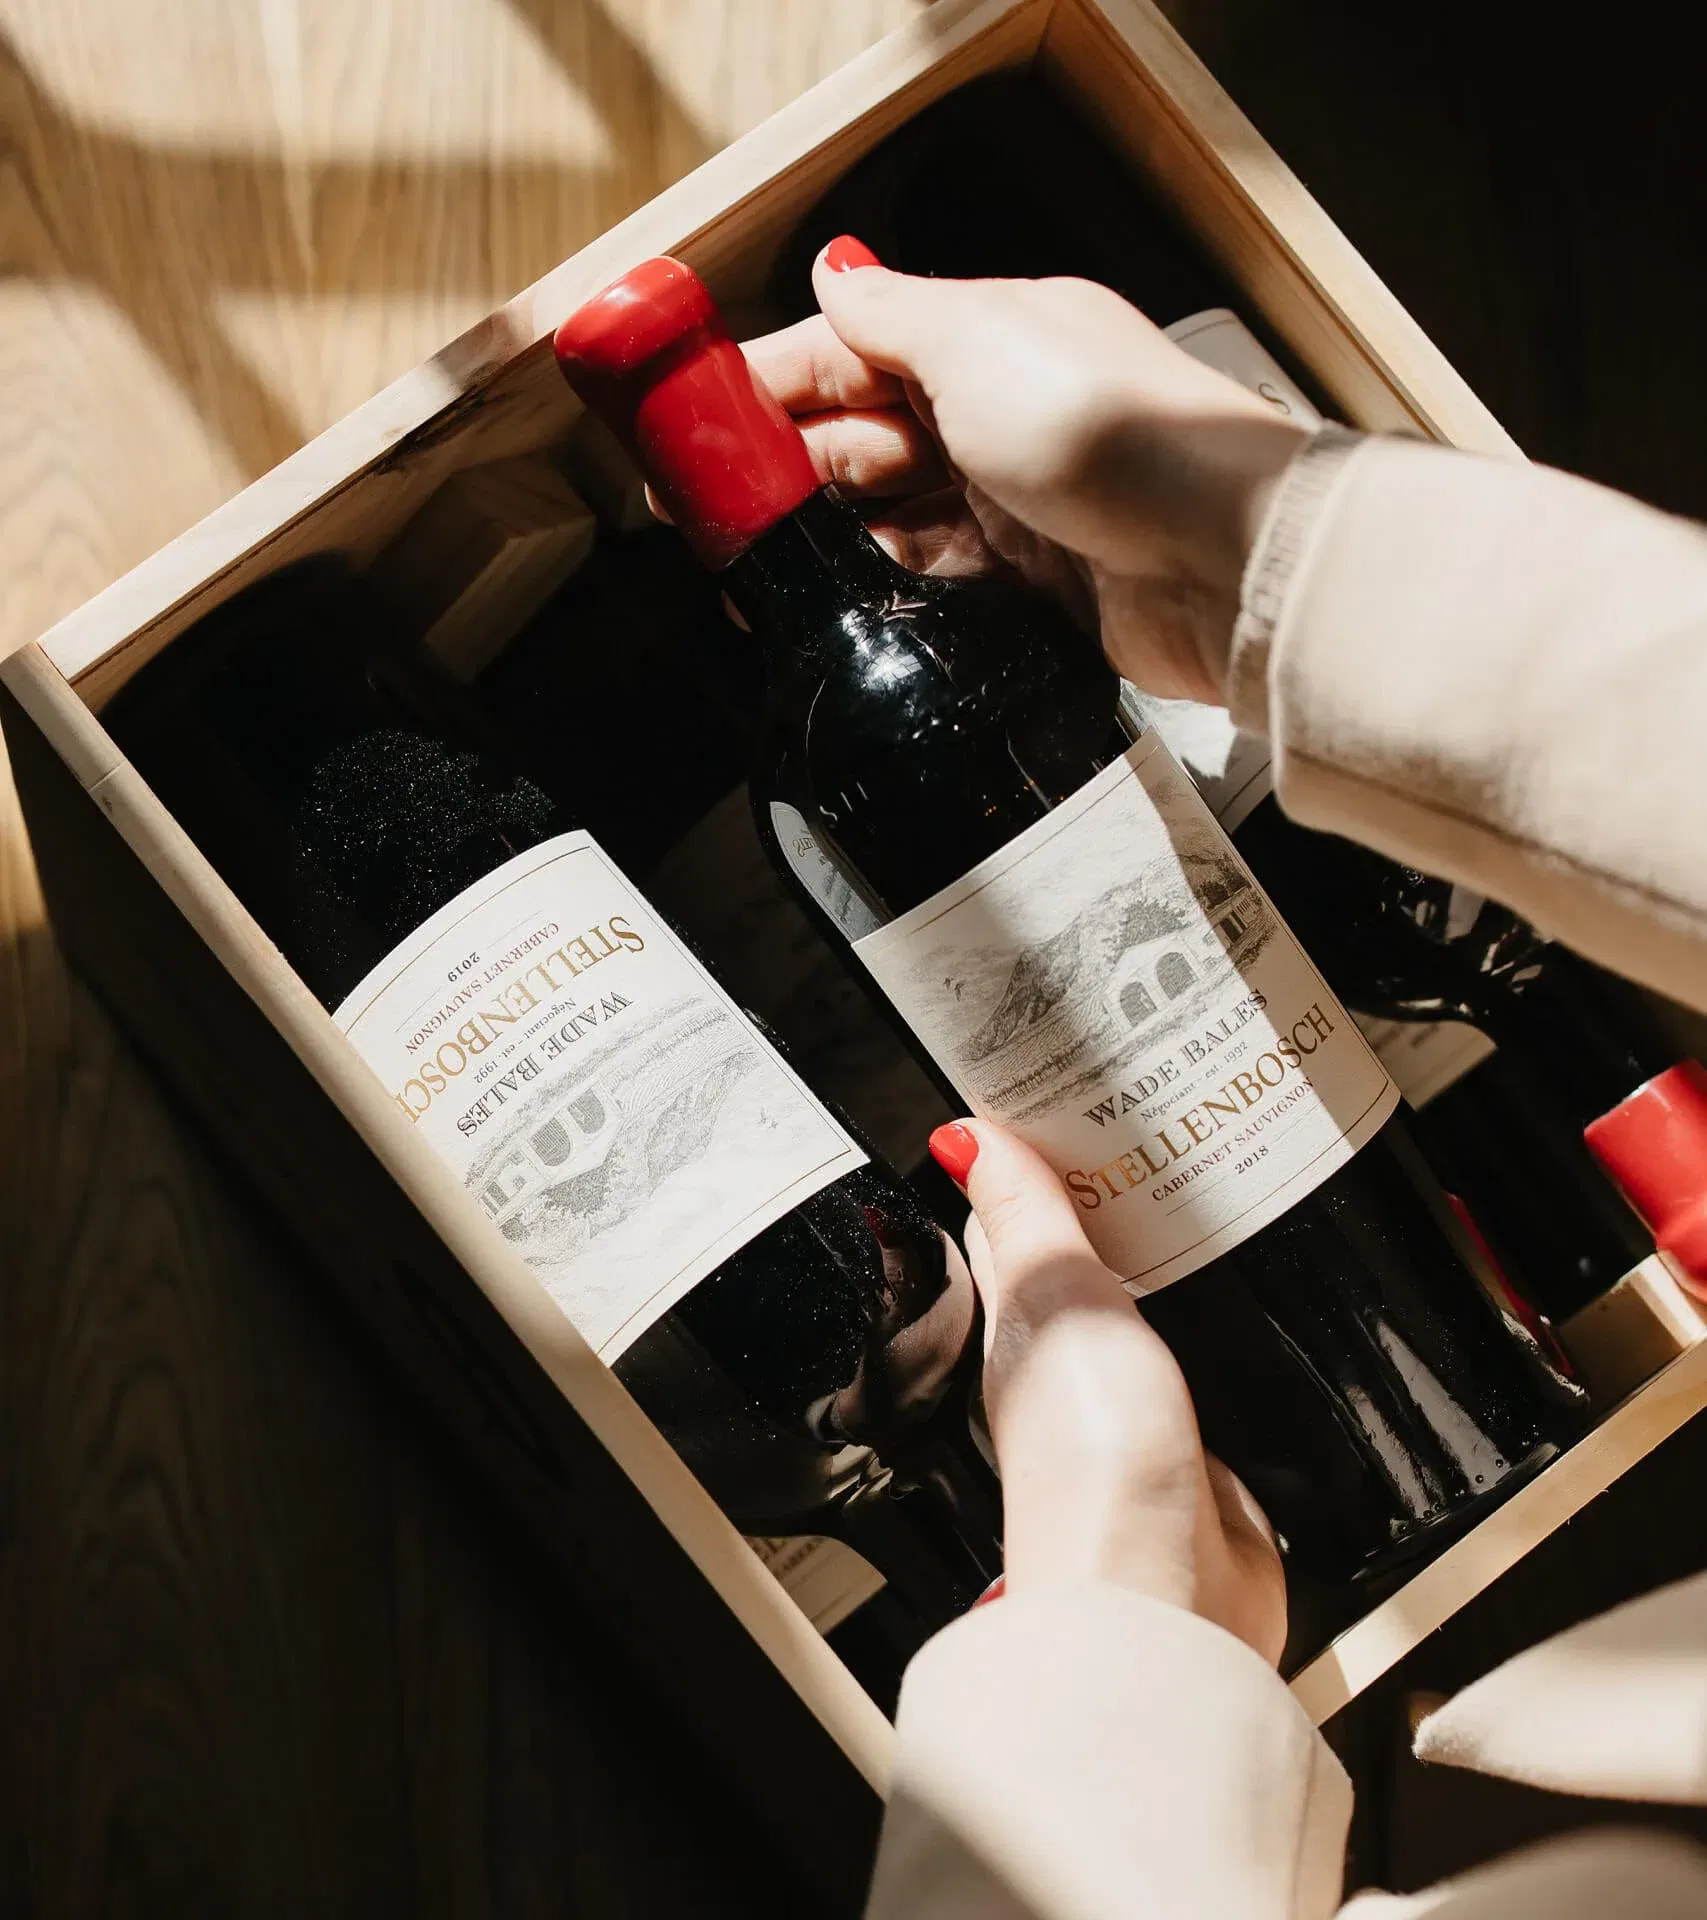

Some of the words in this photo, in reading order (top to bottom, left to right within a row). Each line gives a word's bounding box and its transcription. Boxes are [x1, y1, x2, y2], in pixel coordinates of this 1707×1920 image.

[447, 952, 481, 983] 2019
[483, 922, 560, 983] CABERNET
[404, 980, 482, 1055] SAUVIGNON
[498, 1043, 516, 1059] est.
[524, 997, 577, 1039] Négociant
[540, 991, 634, 1061] WADE
[474, 1059, 499, 1084] 1992
[1082, 1059, 1181, 1128] WADE
[1179, 988, 1268, 1067] BALES
[1140, 1082, 1198, 1123] Négociant
[1205, 1062, 1223, 1079] est.
[1224, 1041, 1248, 1063] 1992
[457, 1053, 544, 1138] BALES
[1065, 1003, 1335, 1210] STELLENBOSCH
[1152, 1143, 1233, 1202] CABERNET
[1234, 1076, 1315, 1146] SAUVIGNON
[1234, 1145, 1269, 1175] 2018
